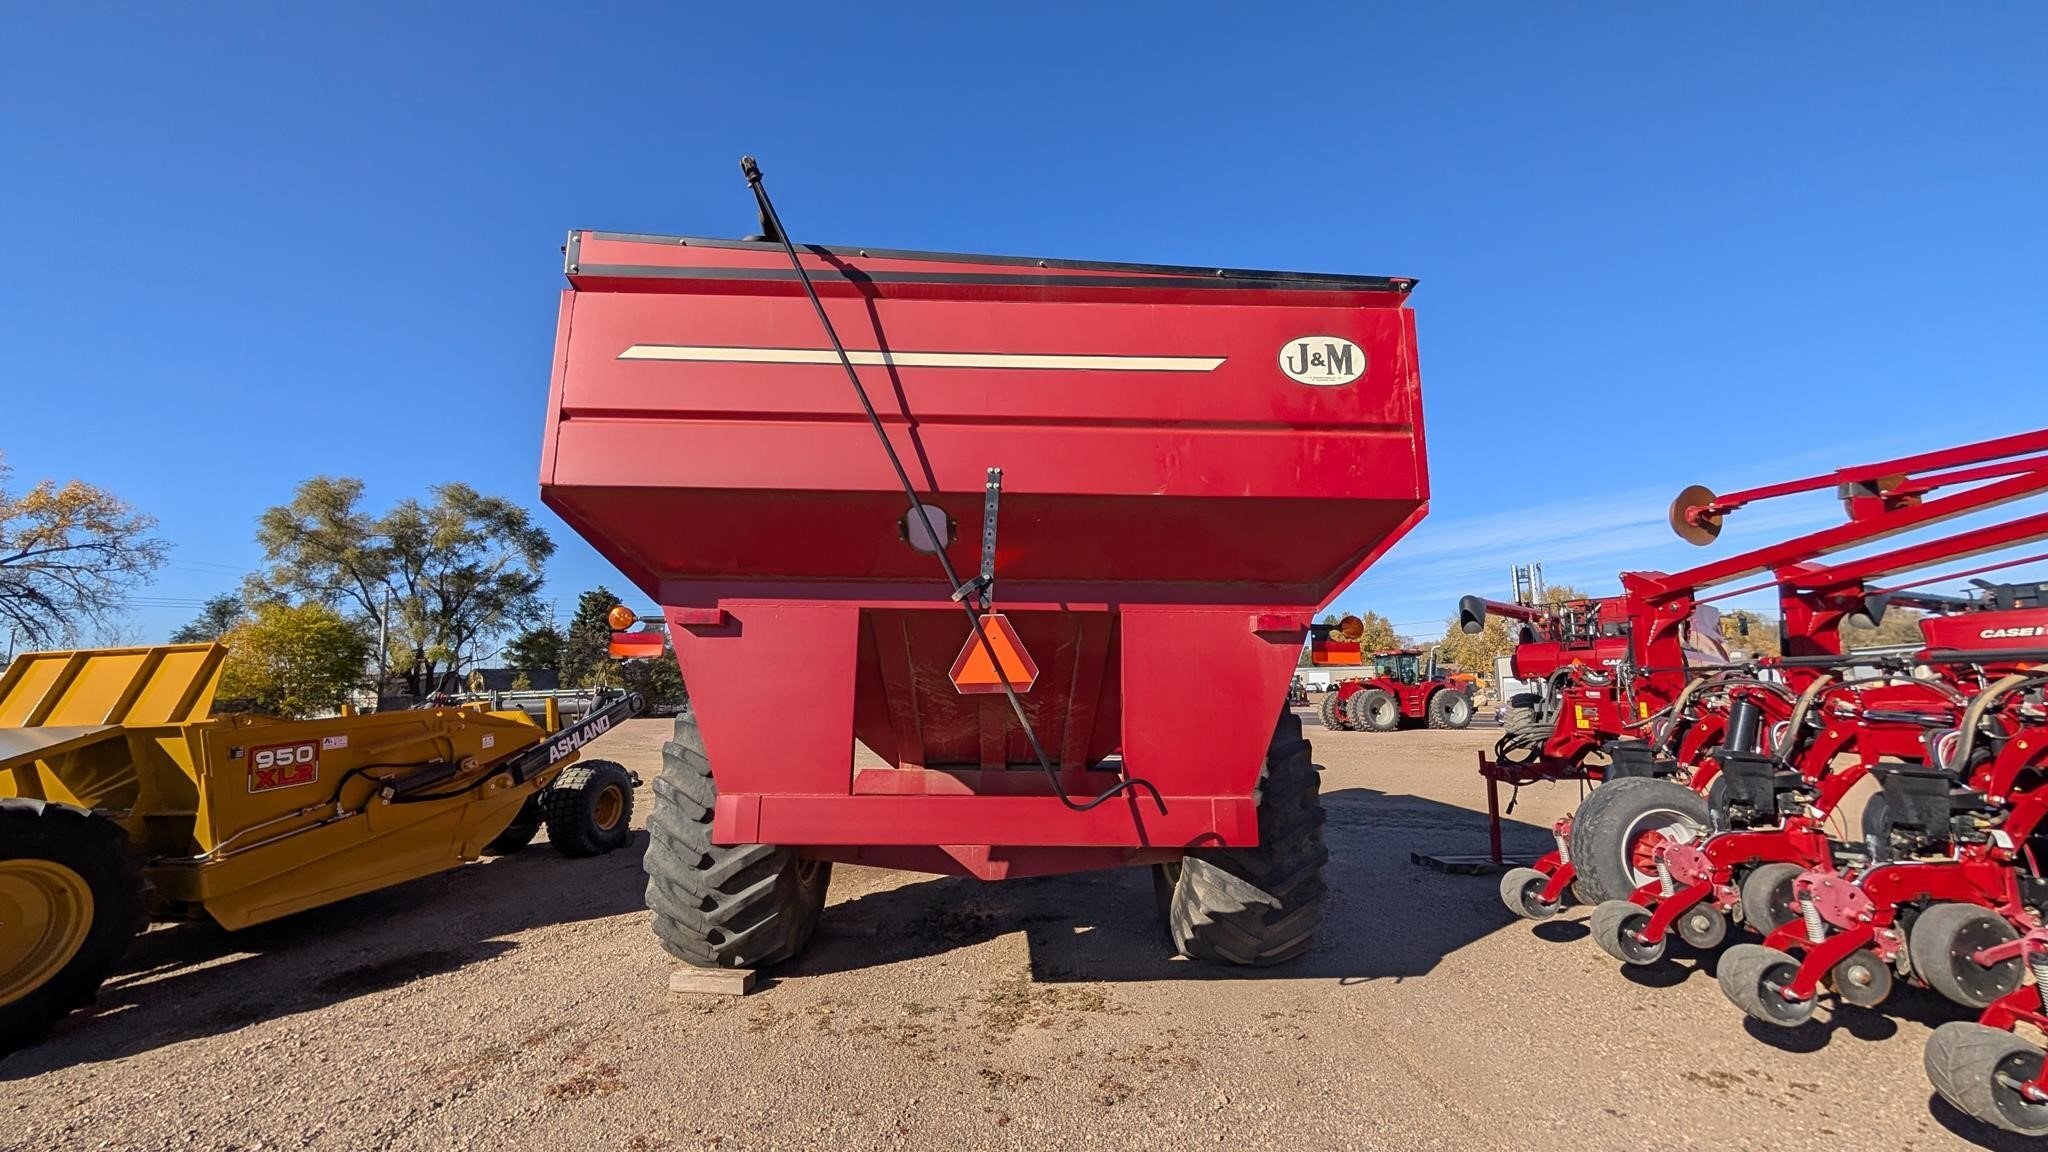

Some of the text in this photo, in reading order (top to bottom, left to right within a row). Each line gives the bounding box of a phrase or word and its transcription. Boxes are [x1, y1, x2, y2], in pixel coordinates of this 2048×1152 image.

[1286, 343, 1355, 376] J&M
[1979, 627, 2035, 639] CASE
[549, 714, 611, 765] ASHLAND
[255, 745, 314, 769] 950
[255, 764, 314, 791] XL2
